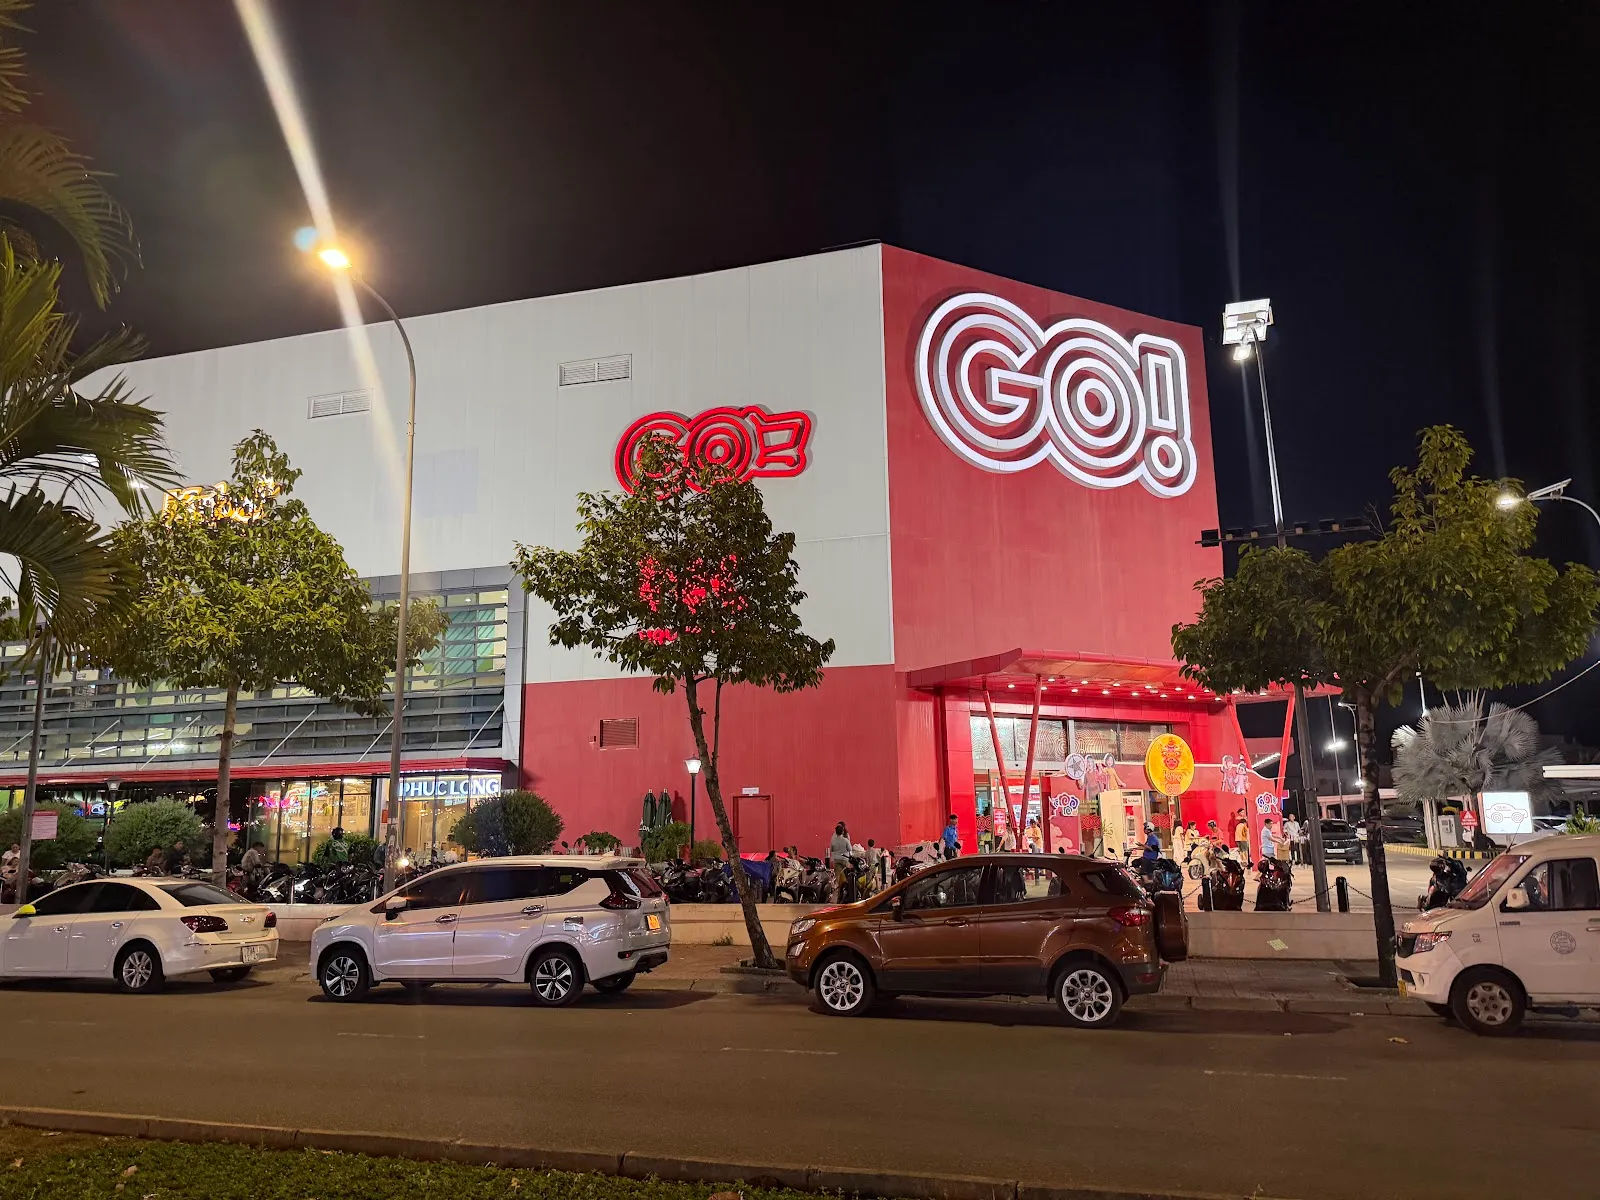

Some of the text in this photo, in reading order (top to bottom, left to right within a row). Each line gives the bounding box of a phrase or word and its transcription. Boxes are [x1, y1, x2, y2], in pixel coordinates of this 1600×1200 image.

[916, 292, 1198, 498] GO!
[399, 779, 499, 797] PHUC LONG
